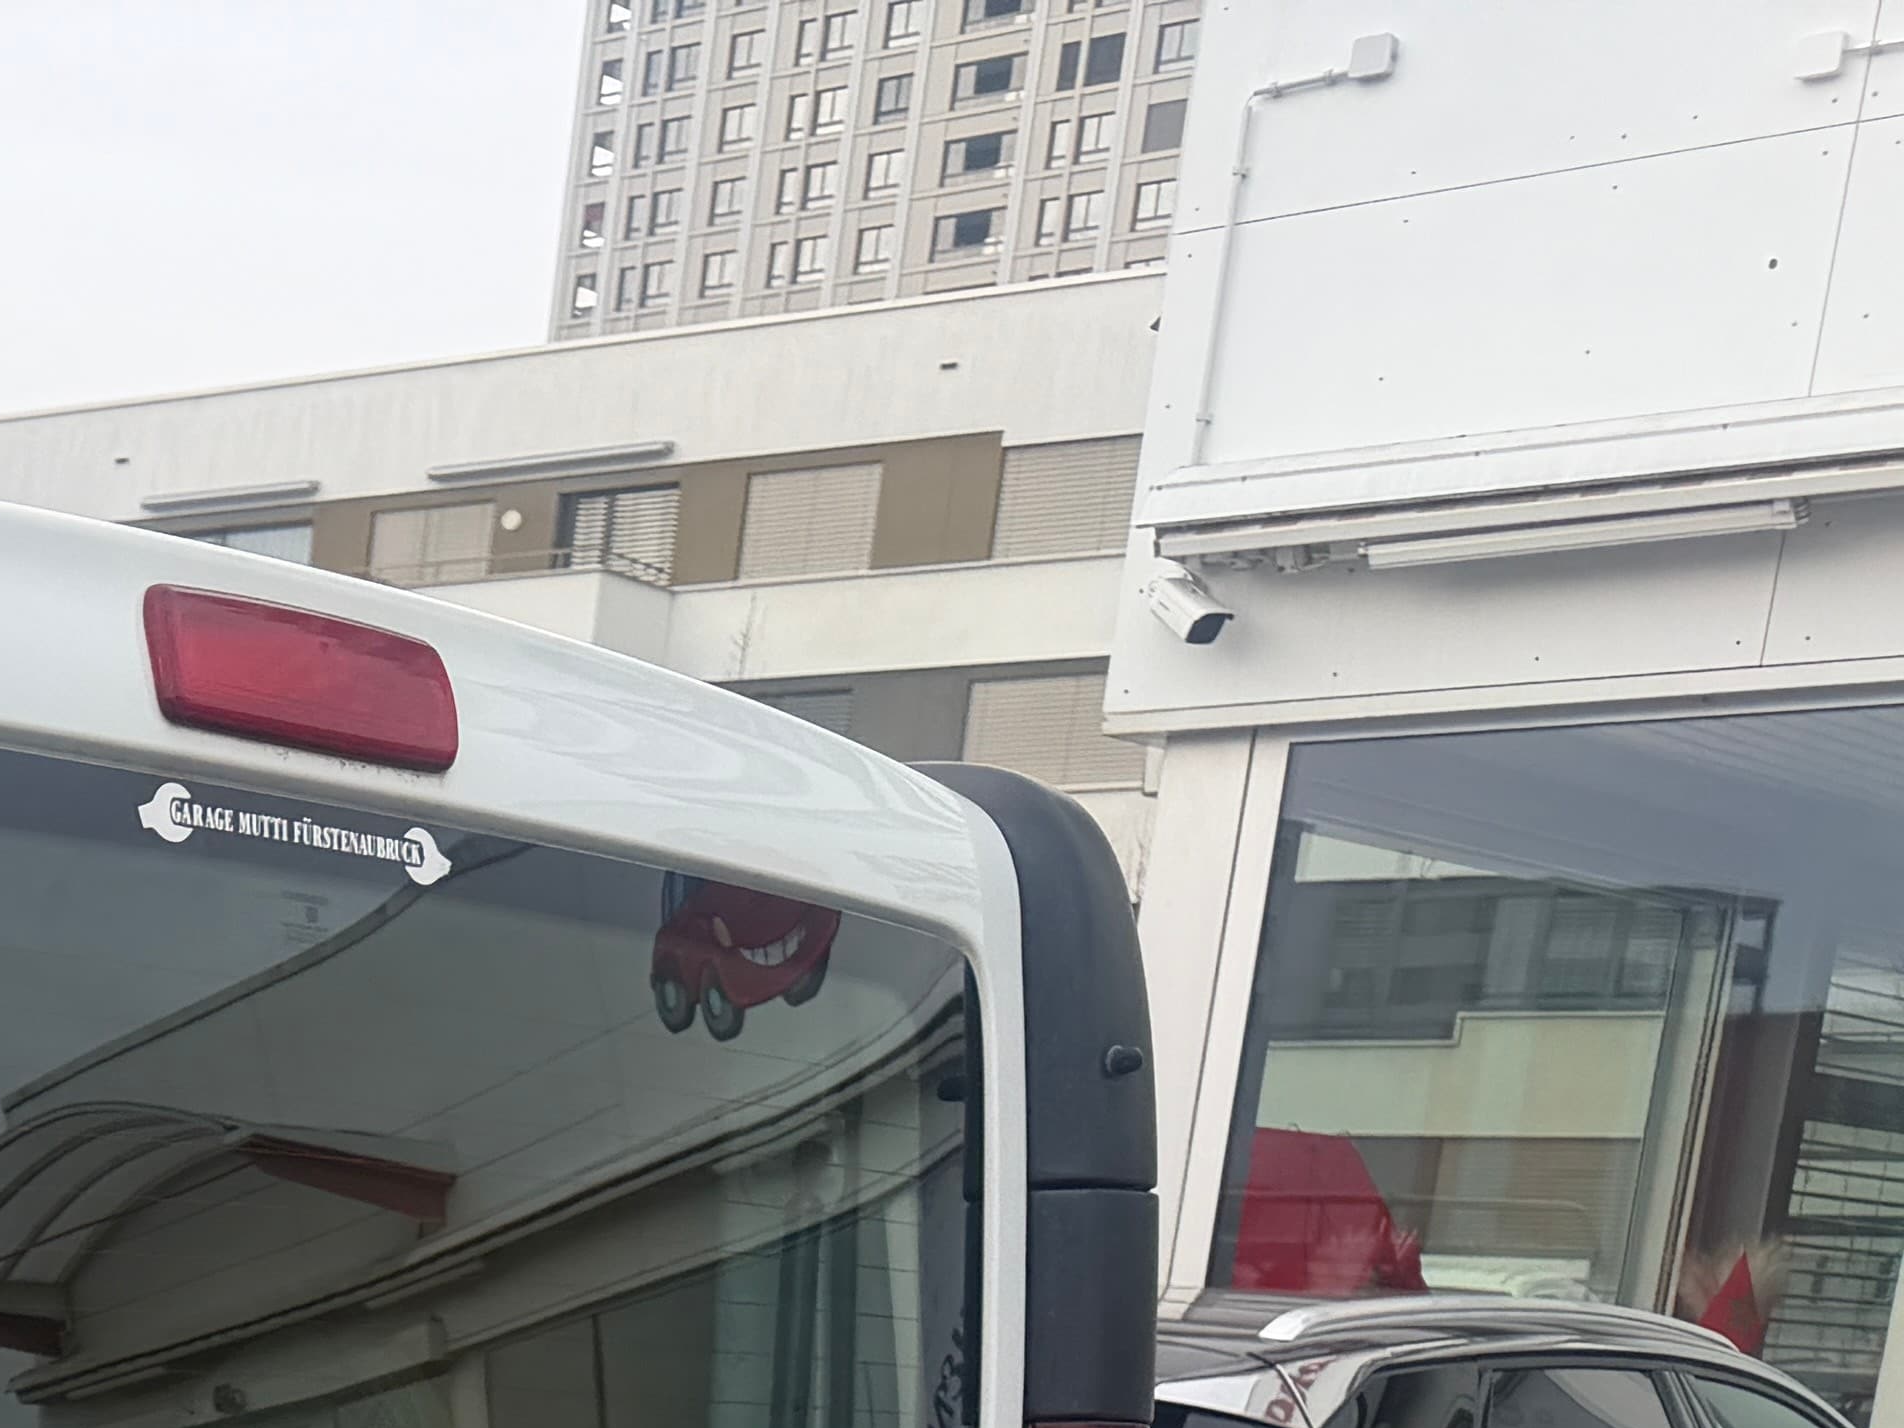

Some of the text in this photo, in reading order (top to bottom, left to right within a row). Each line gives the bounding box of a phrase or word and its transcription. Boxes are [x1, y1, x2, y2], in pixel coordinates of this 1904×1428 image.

[170, 799, 422, 866] GARAGE MUTTI FÜRSTENAUBRUCK
